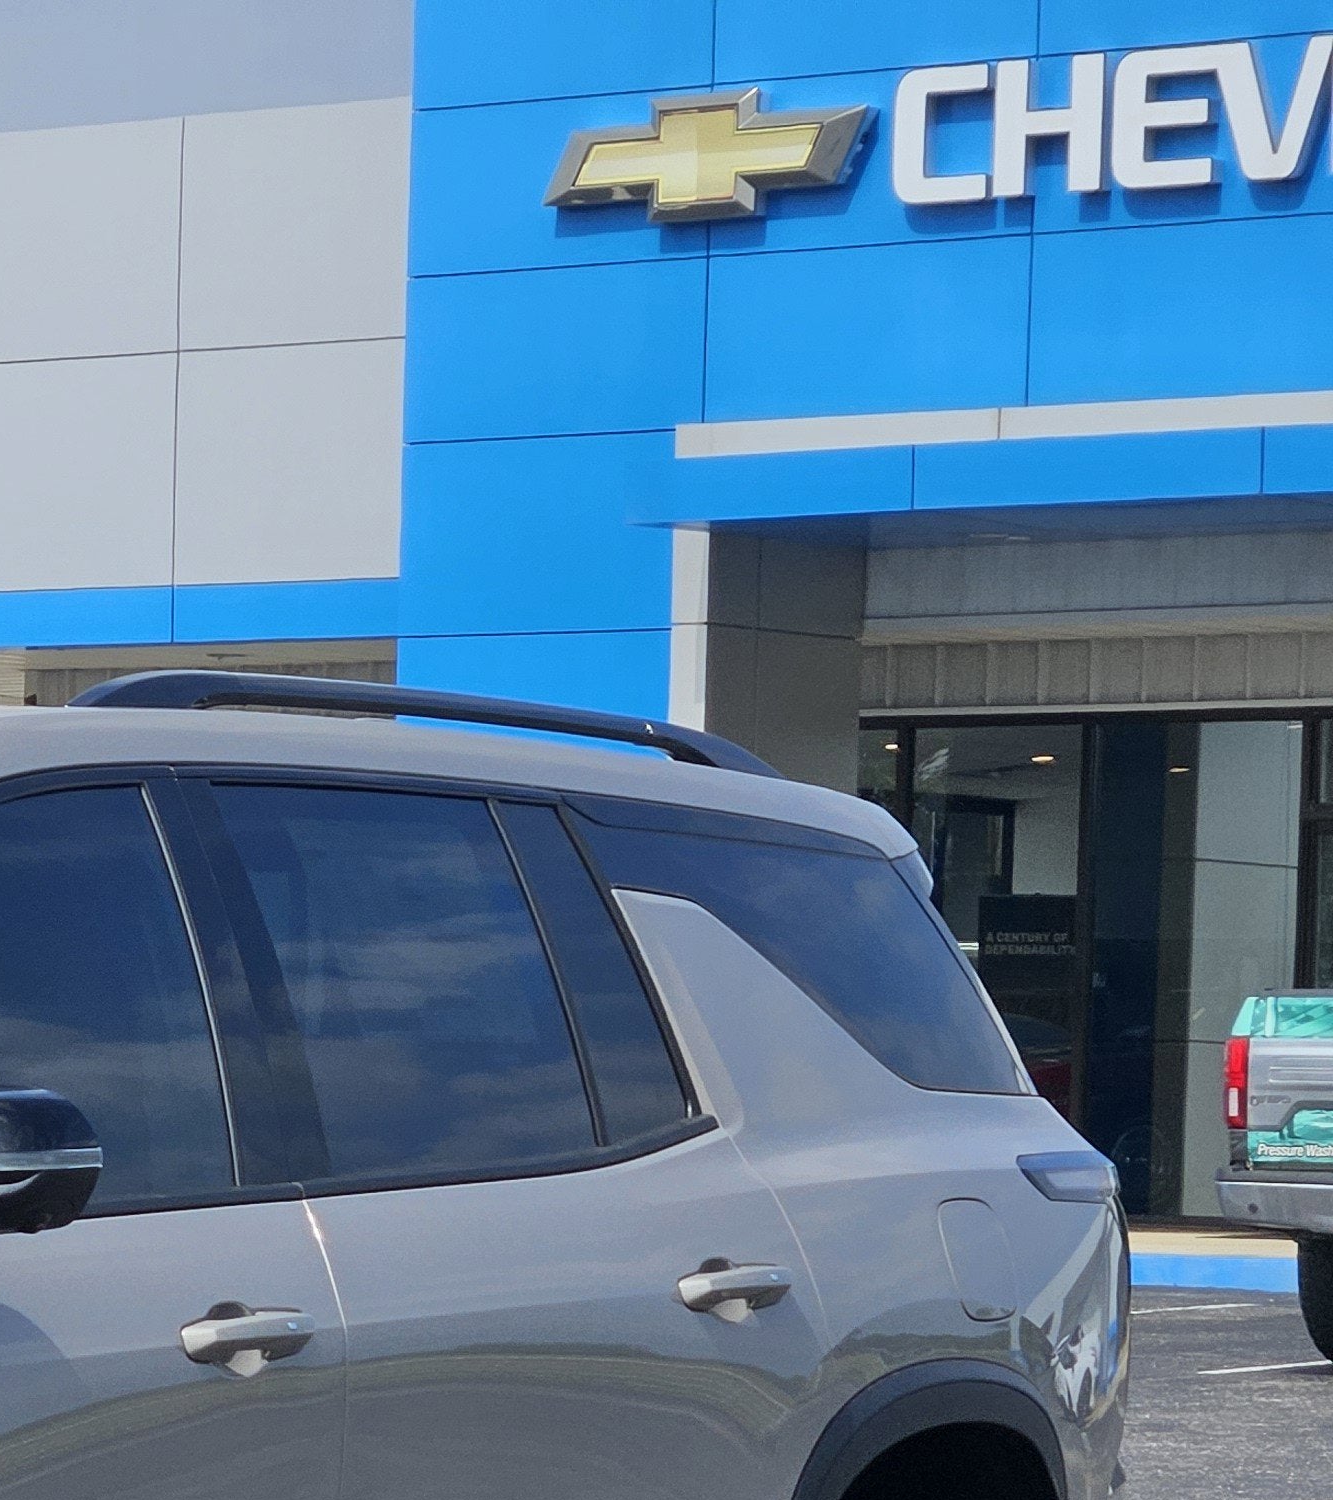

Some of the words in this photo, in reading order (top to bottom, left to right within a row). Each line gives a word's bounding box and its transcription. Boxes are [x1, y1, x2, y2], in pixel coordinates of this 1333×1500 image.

[892, 33, 1333, 206] CHEV
[996, 931, 1051, 942] CENTURY
[1257, 1142, 1304, 1156] Pressure
